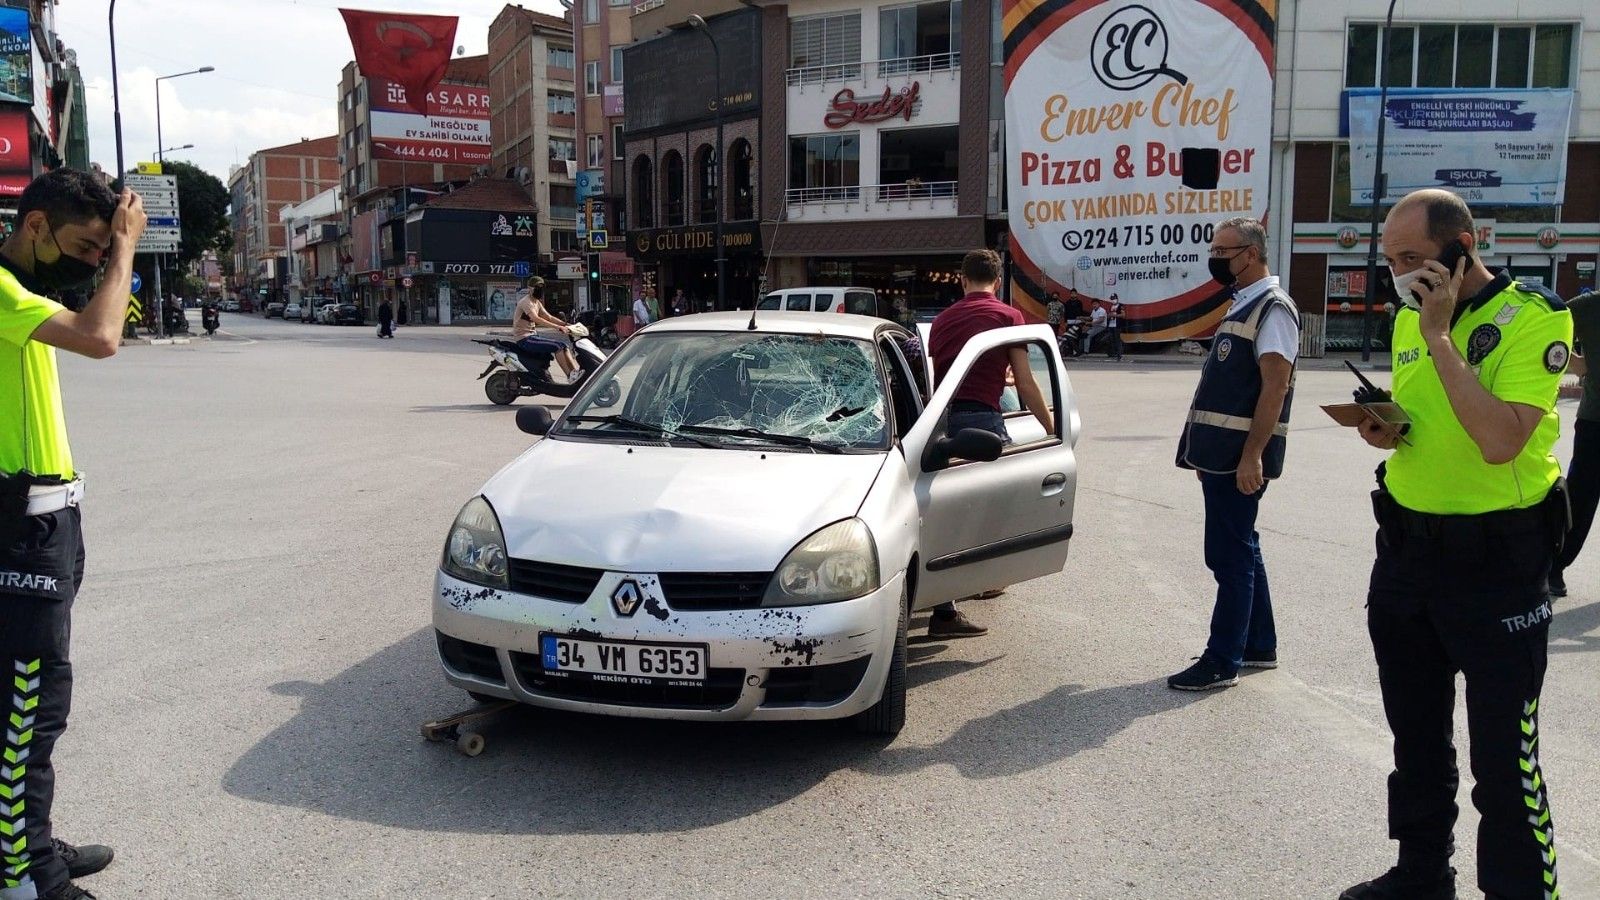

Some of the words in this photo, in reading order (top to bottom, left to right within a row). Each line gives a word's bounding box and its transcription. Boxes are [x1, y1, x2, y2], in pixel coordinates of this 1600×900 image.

[426, 91, 490, 108] ASARR
[824, 81, 919, 129] Sedef
[1411, 102, 1442, 110] ENGELLİ
[1445, 102, 1453, 110] VE
[1455, 102, 1472, 110] ESKİ
[1475, 102, 1511, 110] HÜKÜMLÜ
[1040, 94, 1147, 143] Enver
[1151, 82, 1239, 141] Chef
[1426, 110, 1448, 118] KENDİ
[1470, 110, 1497, 118] KURMA
[430, 119, 479, 132] İNEGÖL'DE
[1428, 119, 1480, 128] BAŞVURULARI
[1482, 119, 1513, 128] BAŞLADI
[405, 129, 417, 137] EV
[420, 130, 449, 139] SAHİBİ
[452, 133, 483, 142] OLMAK
[394, 145, 415, 156] 444
[418, 147, 425, 156] 4
[428, 147, 449, 158] 404
[1021, 151, 1101, 187] Pizza
[1113, 144, 1134, 179] &
[1147, 141, 1255, 178] Buer
[1023, 199, 1066, 229] ÇOK
[1072, 193, 1158, 221] YAKINDA
[1164, 186, 1253, 215] SİZLERLE
[656, 229, 681, 251] GÜL
[684, 228, 714, 249] PİDE
[722, 234, 733, 247] 710
[1083, 228, 1118, 250] 224
[1124, 224, 1154, 247] 715
[1160, 223, 1184, 245] 00
[1093, 250, 1199, 267] www.enverchef.com
[444, 263, 480, 274] FOTO
[1118, 267, 1170, 281] enver.chef
[546, 654, 556, 663] TR
[557, 641, 585, 668] 34
[597, 644, 626, 672] VM
[639, 648, 699, 676] 6353
[593, 674, 627, 683] HEKİM
[630, 676, 652, 685] OTO
